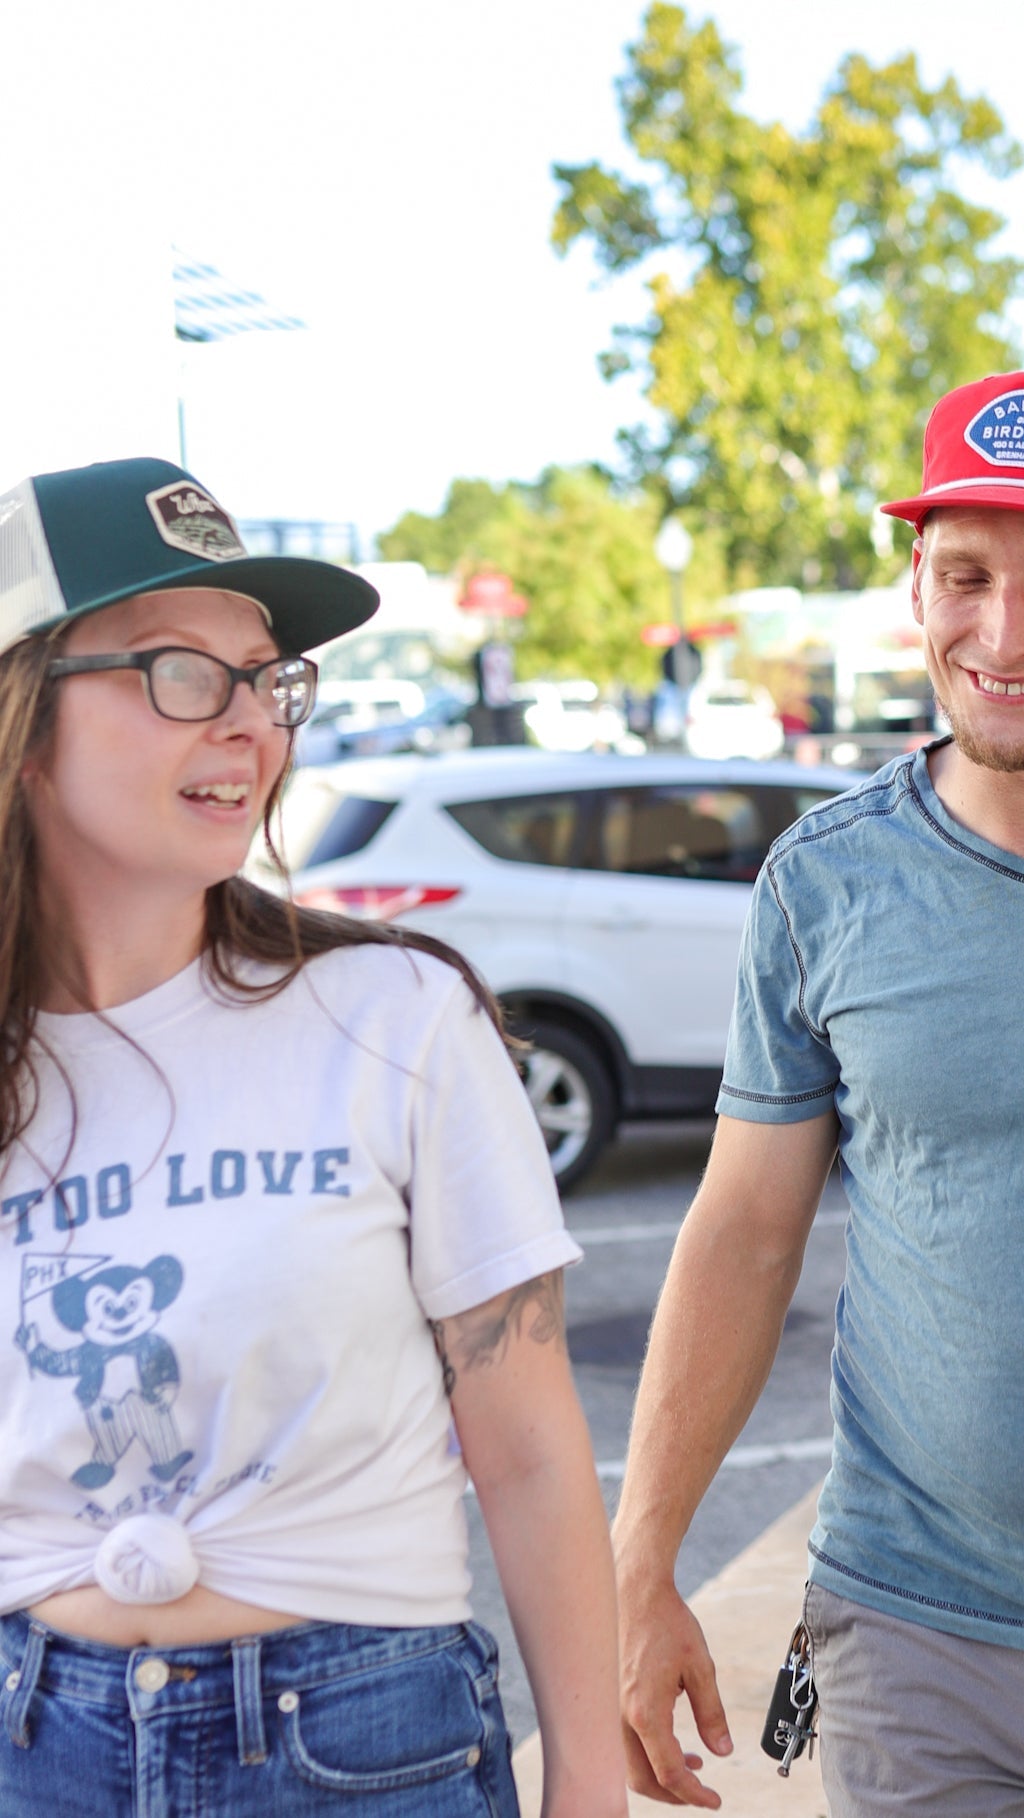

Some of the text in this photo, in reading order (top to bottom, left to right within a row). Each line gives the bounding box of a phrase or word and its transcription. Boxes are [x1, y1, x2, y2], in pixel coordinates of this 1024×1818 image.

[982, 425, 1024, 440] BIRD
[1, 1147, 351, 1246] TOO LOVE
